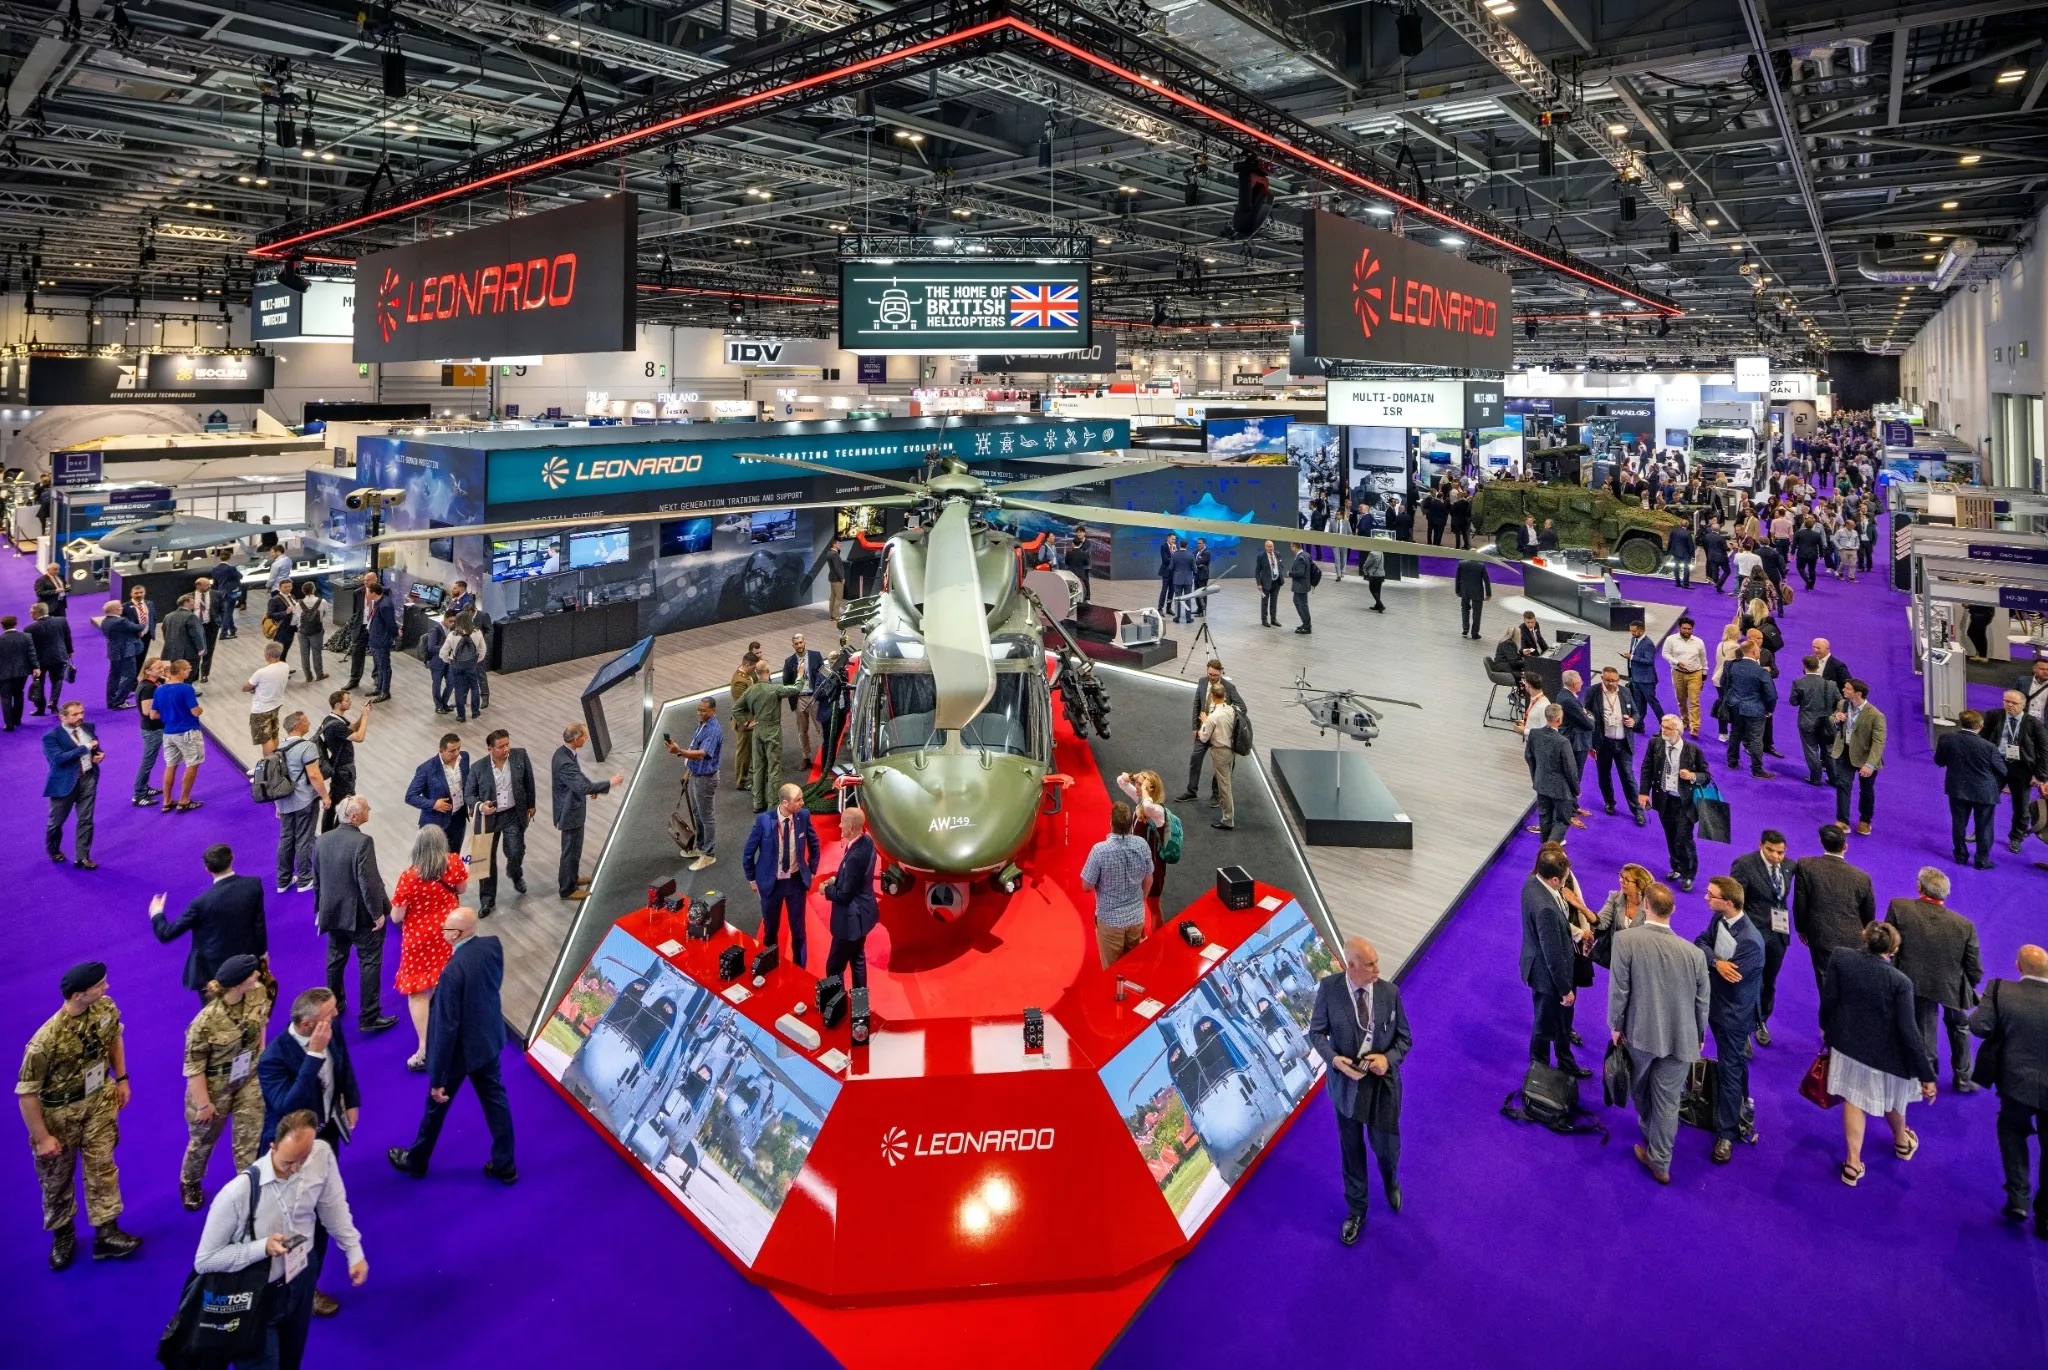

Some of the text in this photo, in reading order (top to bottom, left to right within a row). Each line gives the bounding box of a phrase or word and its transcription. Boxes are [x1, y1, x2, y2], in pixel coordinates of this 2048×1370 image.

[405, 252, 577, 323] LEONARDO
[925, 286, 1007, 298] THE HOME OF
[260, 295, 290, 311] MULTI-DOMAIN
[927, 299, 1006, 315] BRITISH
[1389, 276, 1497, 337] LEONARDO
[262, 312, 288, 326] PROTECTION
[927, 316, 1006, 327] HELICOPTERS
[731, 343, 782, 362] IDV
[515, 364, 528, 377] 9
[644, 361, 655, 378] 8
[931, 366, 937, 379] 7
[1236, 376, 1264, 385] Patria
[657, 392, 699, 403] FINLAND
[1352, 392, 1434, 404] MULTI-DOMAIN
[1382, 407, 1403, 416] ISR
[1482, 407, 1490, 417] ISR
[739, 450, 828, 465] AERATING
[835, 445, 898, 458] TECHNOLOGY
[575, 454, 703, 481] LEONARDO
[103, 503, 151, 511] UMBRAGROUP
[659, 491, 802, 512] NEXT GENERATION TRAINING AND SUPPORT
[928, 816, 971, 833] AW149
[913, 1127, 1055, 1157] LEONARDO
